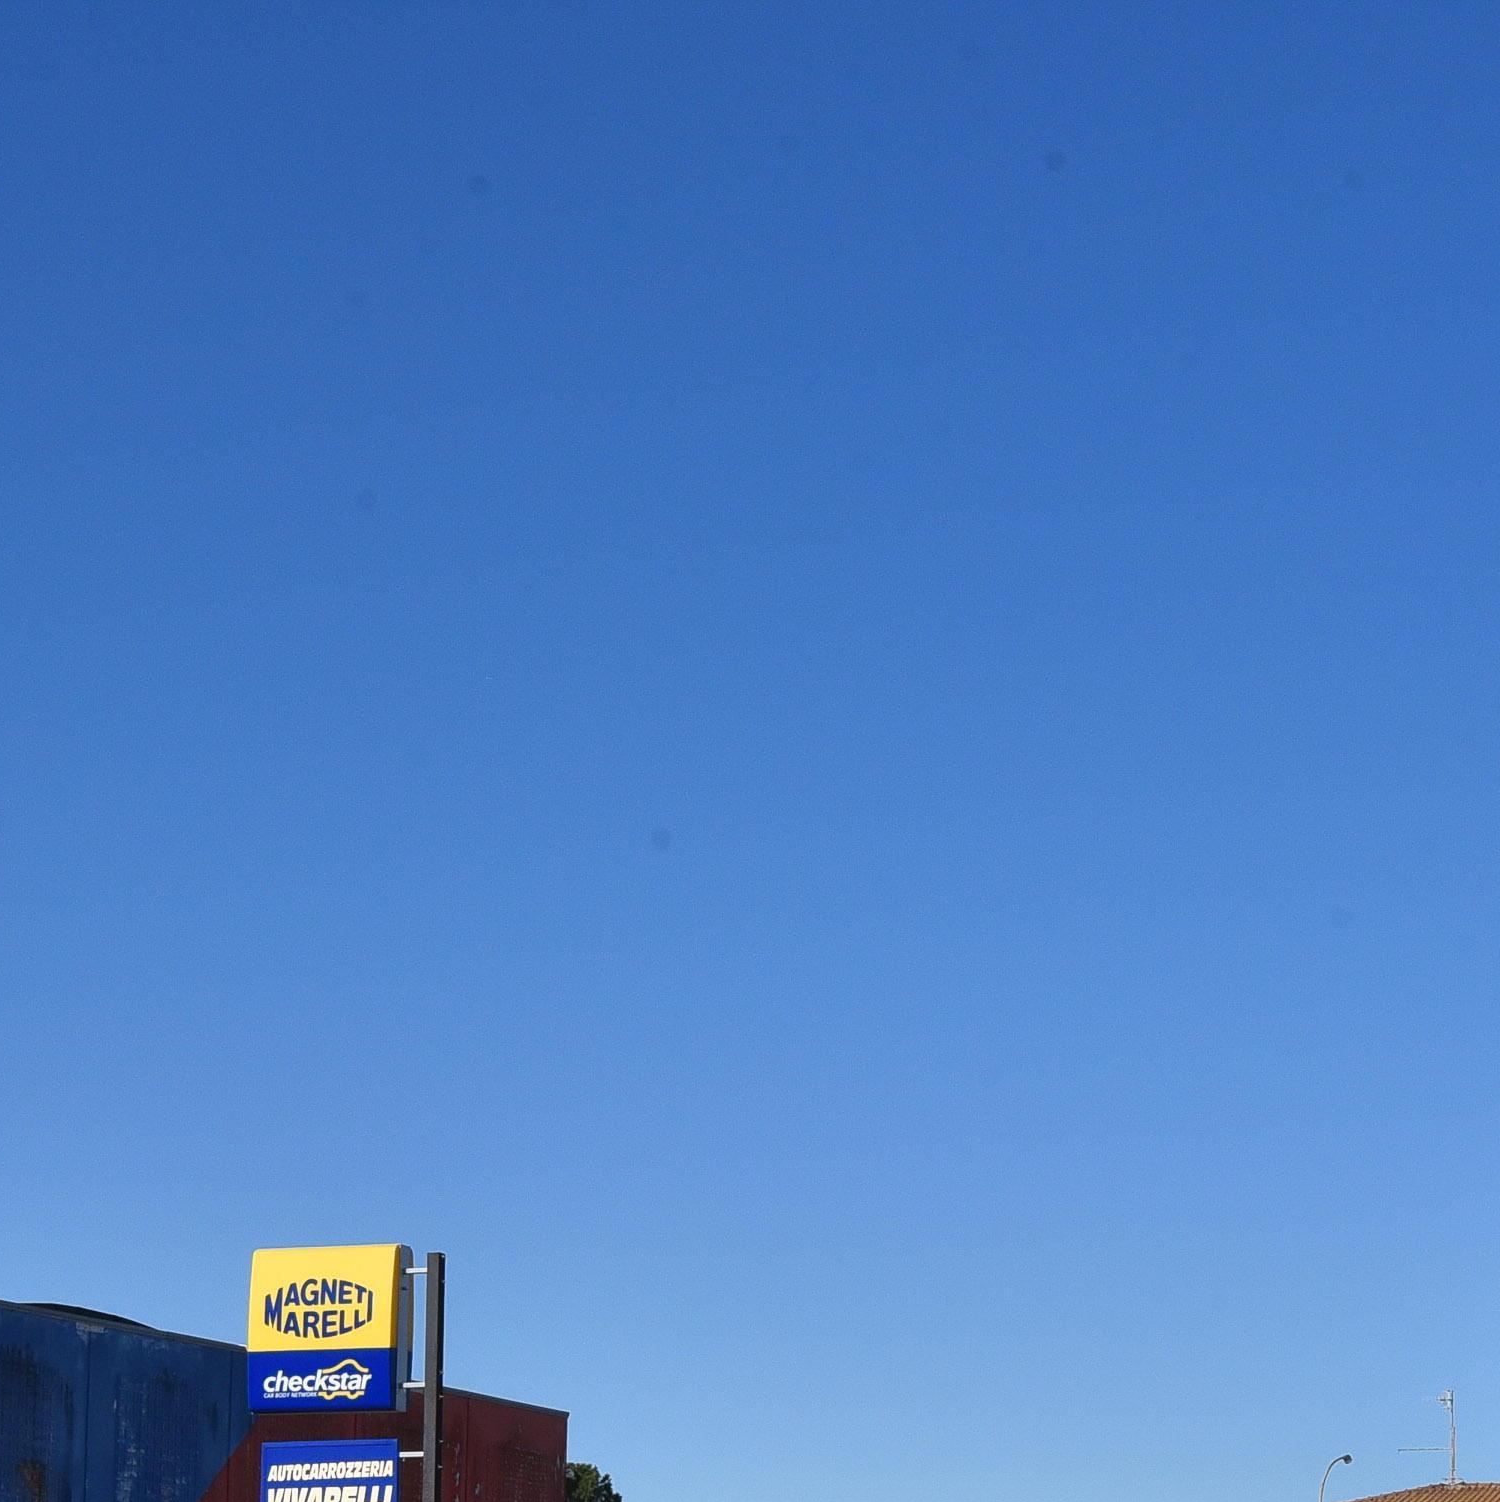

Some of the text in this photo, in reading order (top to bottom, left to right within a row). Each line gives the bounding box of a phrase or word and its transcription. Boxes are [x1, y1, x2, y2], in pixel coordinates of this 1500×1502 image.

[264, 1278, 373, 1320] MAGNETI
[264, 1302, 373, 1338] MARELLI
[263, 1369, 372, 1392] checkstar
[267, 1460, 393, 1482] AUTOCARROZZERIA
